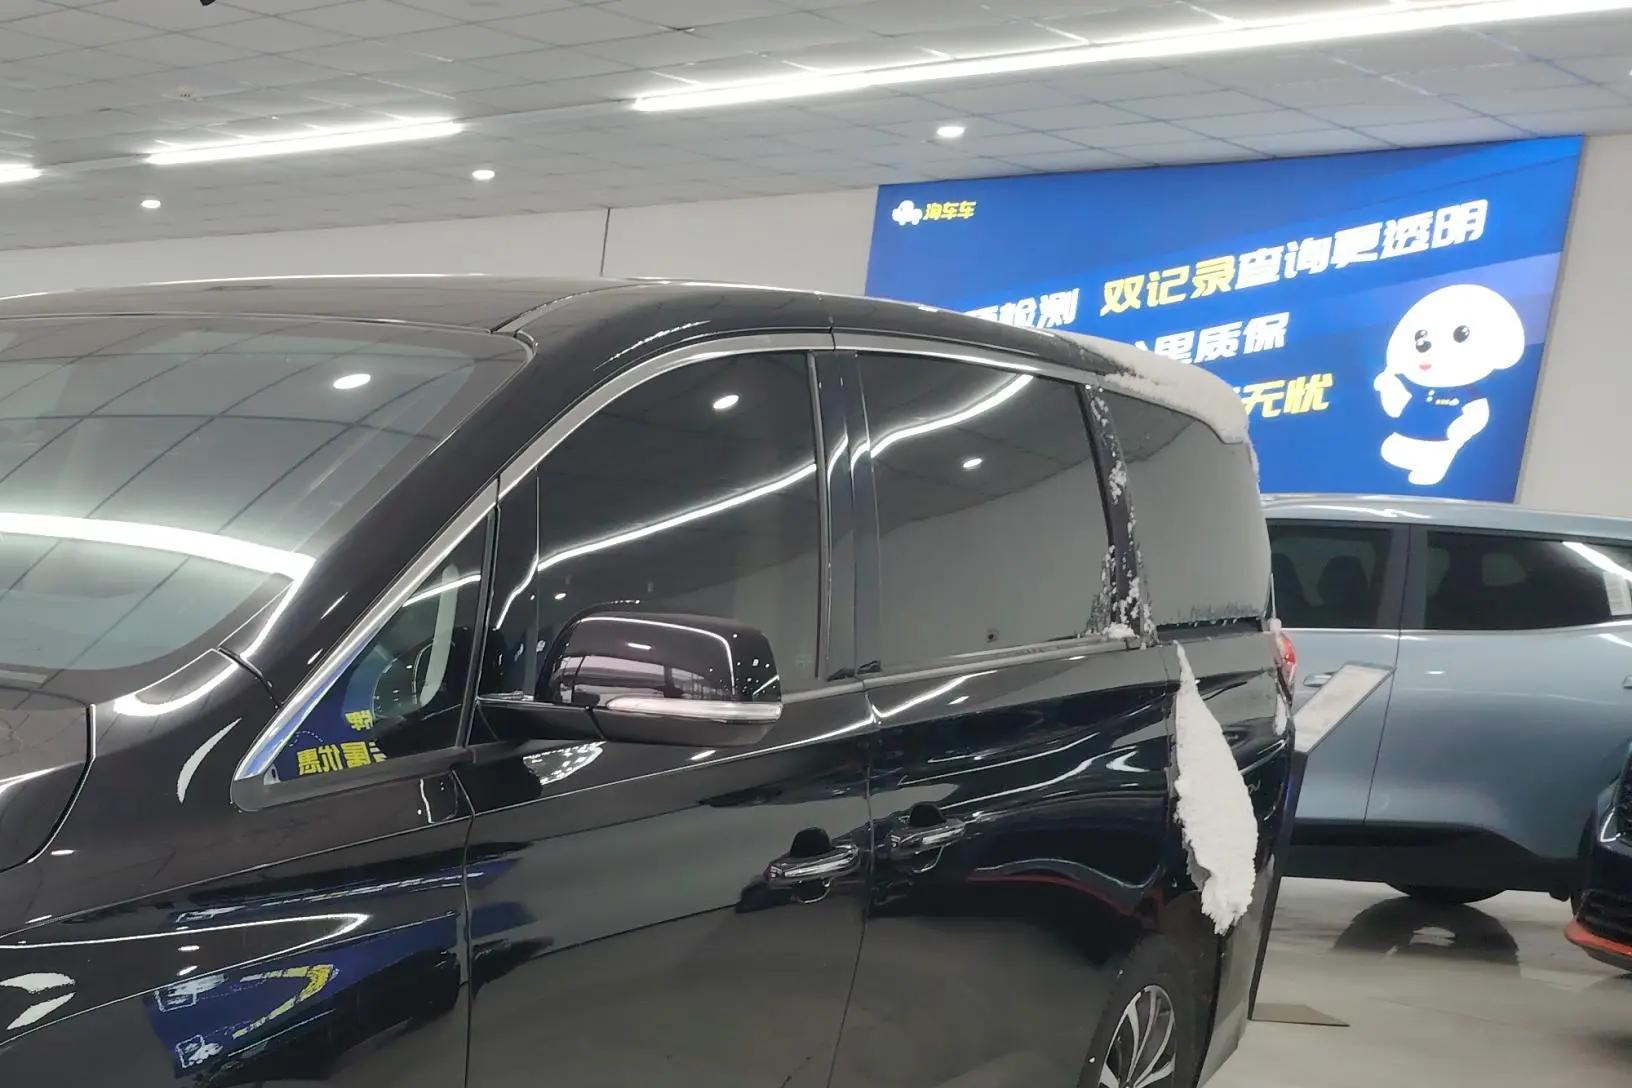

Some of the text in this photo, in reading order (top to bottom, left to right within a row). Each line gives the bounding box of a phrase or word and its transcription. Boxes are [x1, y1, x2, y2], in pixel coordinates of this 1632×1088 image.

[922, 201, 977, 221] 淘车车
[1099, 199, 1489, 316] 双记录查询更透明
[1132, 312, 1290, 364] 里质保
[1234, 373, 1333, 418] 无忧
